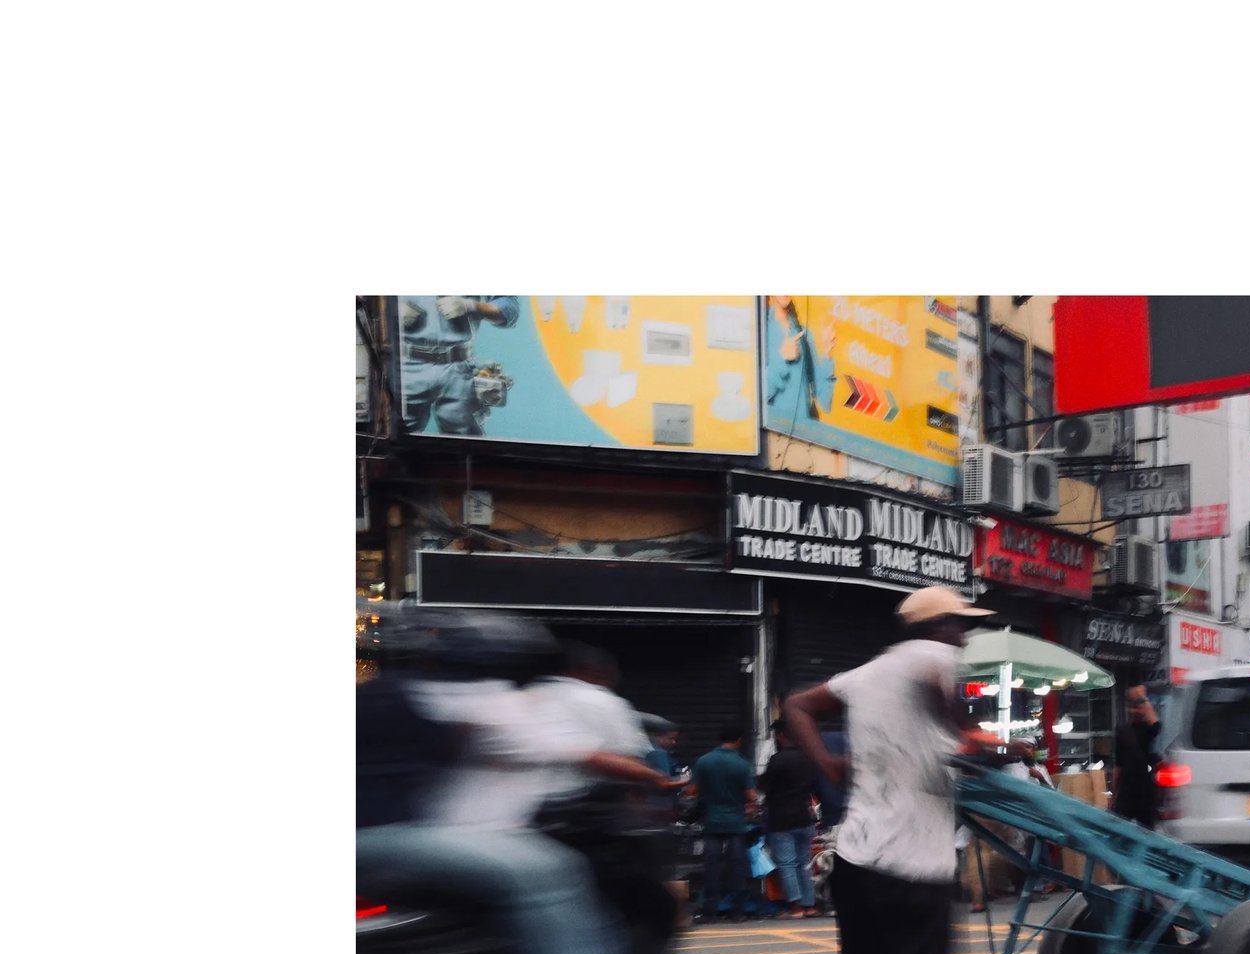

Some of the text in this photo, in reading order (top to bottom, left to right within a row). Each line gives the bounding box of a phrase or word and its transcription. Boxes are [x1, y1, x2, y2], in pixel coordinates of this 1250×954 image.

[1128, 471, 1163, 490] 130
[736, 493, 864, 541] MIDLAND
[1104, 491, 1184, 517] SENA
[867, 498, 974, 558] MIDLAND
[738, 534, 863, 568] TRADE CENTRE
[872, 541, 919, 572] TRADE
[921, 552, 968, 583] CENTRE
[1088, 619, 1134, 648] SENA
